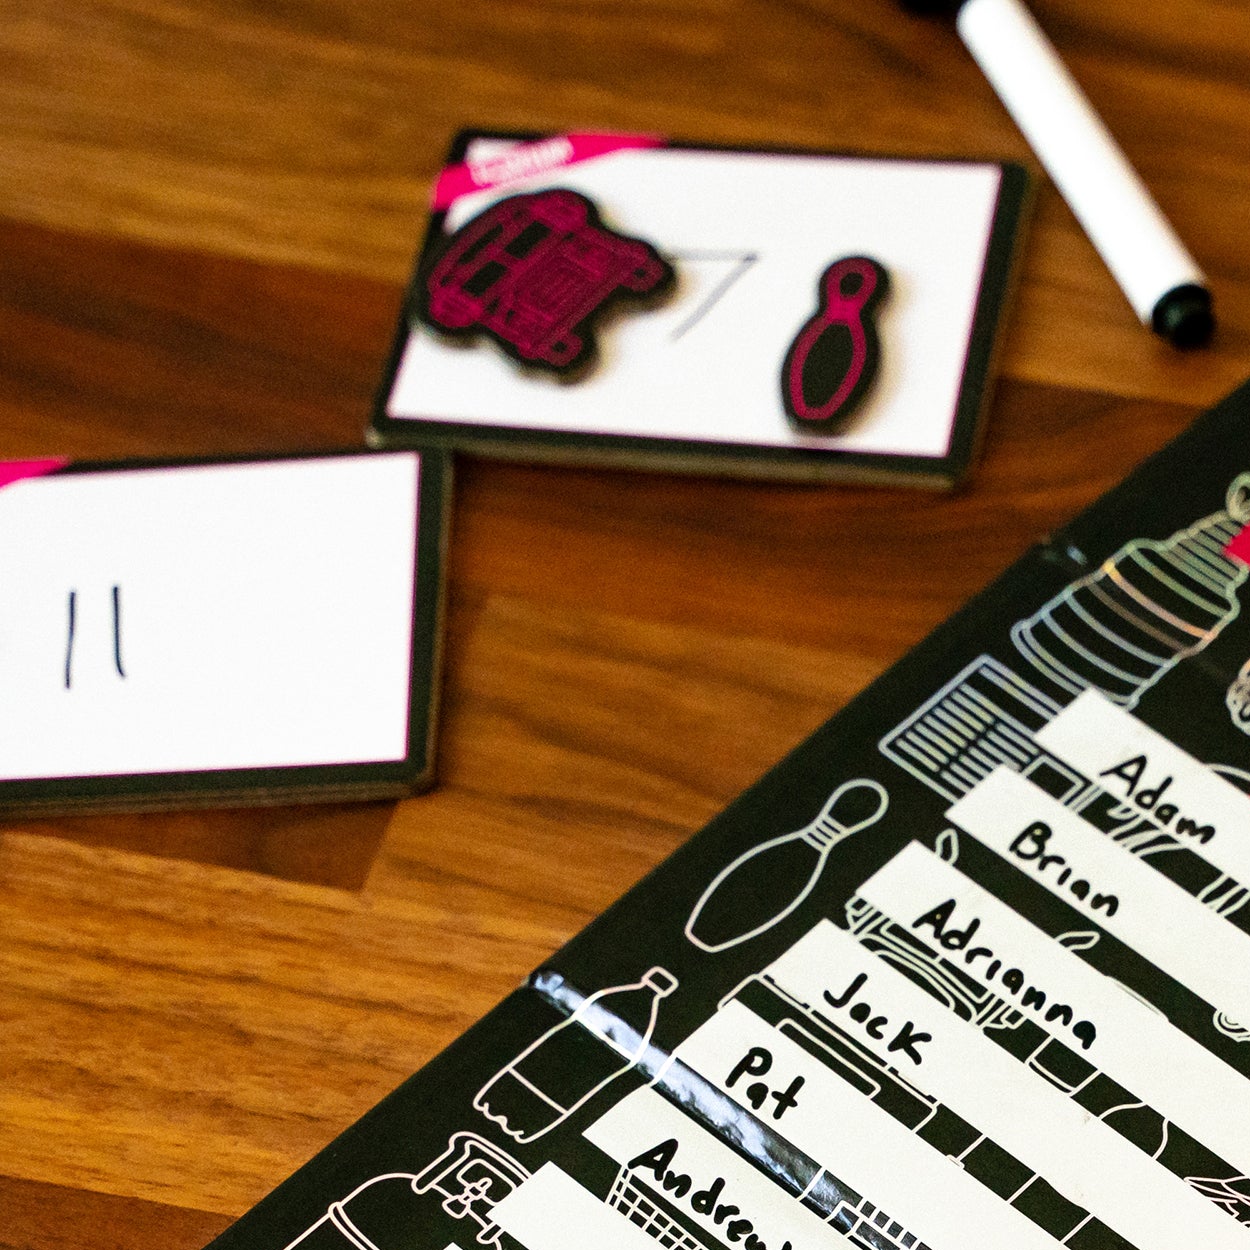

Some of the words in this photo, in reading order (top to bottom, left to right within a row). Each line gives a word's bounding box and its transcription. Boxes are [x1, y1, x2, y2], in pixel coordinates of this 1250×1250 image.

[1100, 755, 1216, 844] Adam
[1009, 821, 1119, 917] Brian
[912, 899, 1097, 1050] Adrianna
[725, 1046, 805, 1120] Pat
